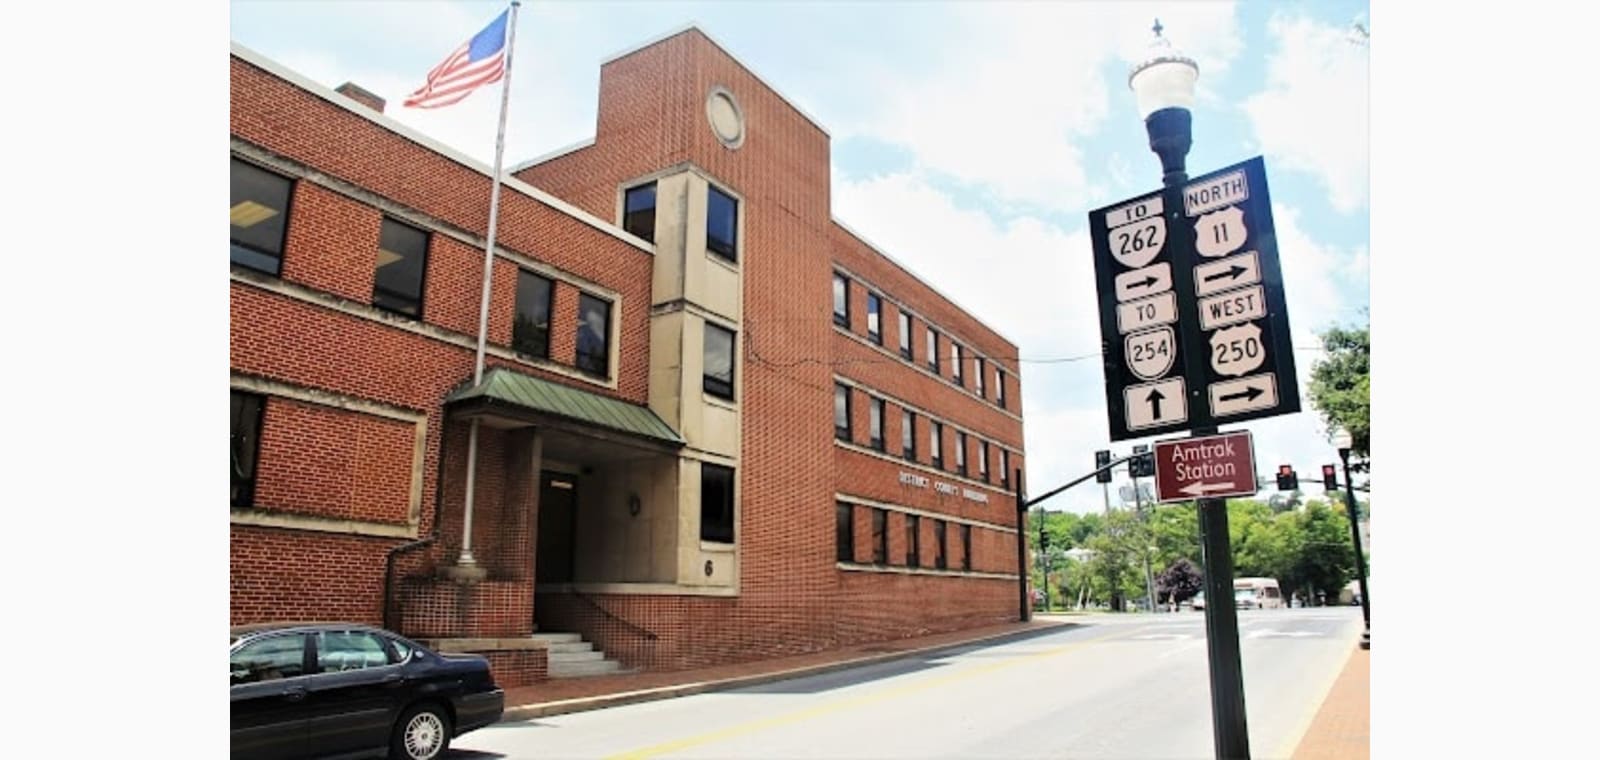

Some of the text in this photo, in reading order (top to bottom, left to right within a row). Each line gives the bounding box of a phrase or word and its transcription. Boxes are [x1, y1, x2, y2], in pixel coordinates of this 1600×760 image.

[1188, 179, 1243, 207] NORTH
[1125, 204, 1147, 221] TO
[1118, 225, 1159, 255] 262
[1213, 223, 1229, 244] 11
[1136, 303, 1156, 321] TO
[1209, 294, 1255, 320] WEST
[1133, 339, 1168, 362] 254
[1215, 337, 1259, 365] 250
[1171, 437, 1236, 463] Amtrak
[1175, 460, 1236, 481] Station
[704, 560, 713, 576] 6
